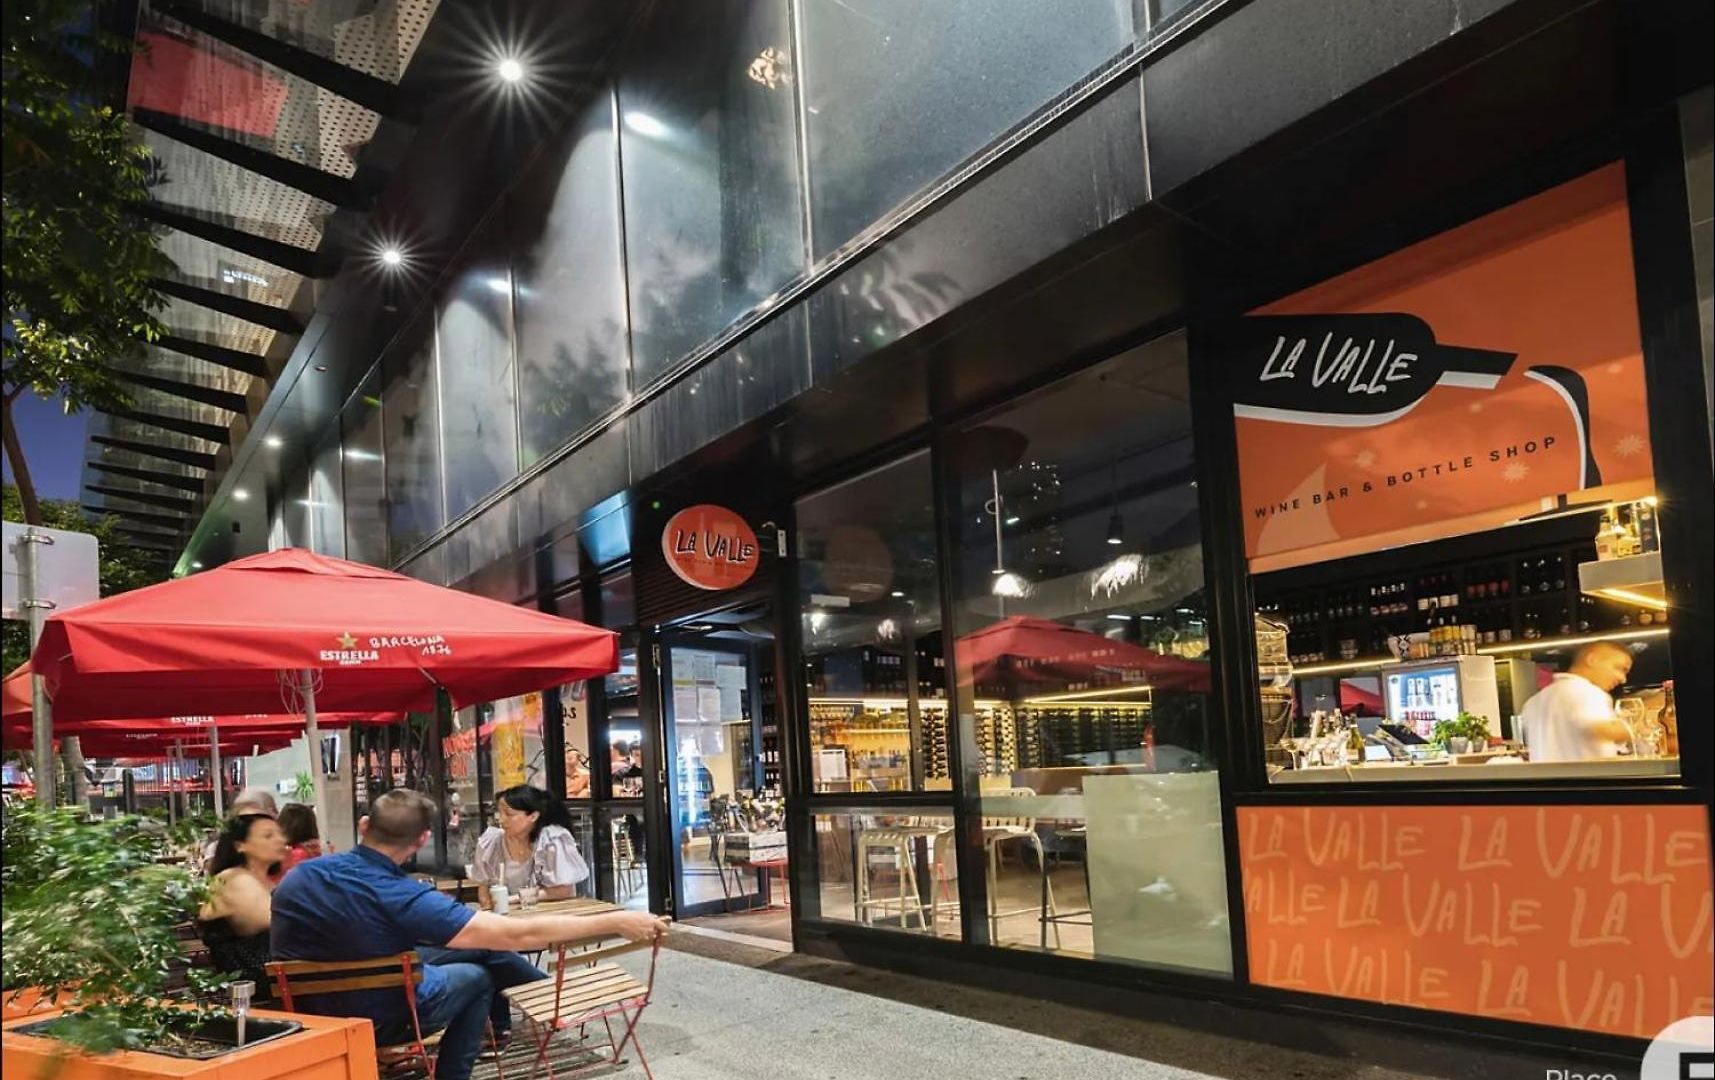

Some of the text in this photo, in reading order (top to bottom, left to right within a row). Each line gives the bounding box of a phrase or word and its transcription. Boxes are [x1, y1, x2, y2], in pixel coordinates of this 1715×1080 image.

[1260, 331, 1418, 394] LA VALLE
[1254, 436, 1557, 519] WINE BAR & BOTTLE SHOP
[675, 529, 753, 564] LA VALLE
[319, 650, 379, 661] ESTRELLA
[368, 634, 446, 649] BARCELONA
[1248, 807, 1706, 885] LA VALLE LA VALLE
[1244, 868, 1714, 959] ALLE LA VALLE LA V
[1266, 938, 1308, 986] LA
[1323, 937, 1452, 1008] VALLE
[1477, 960, 1531, 1016] LA
